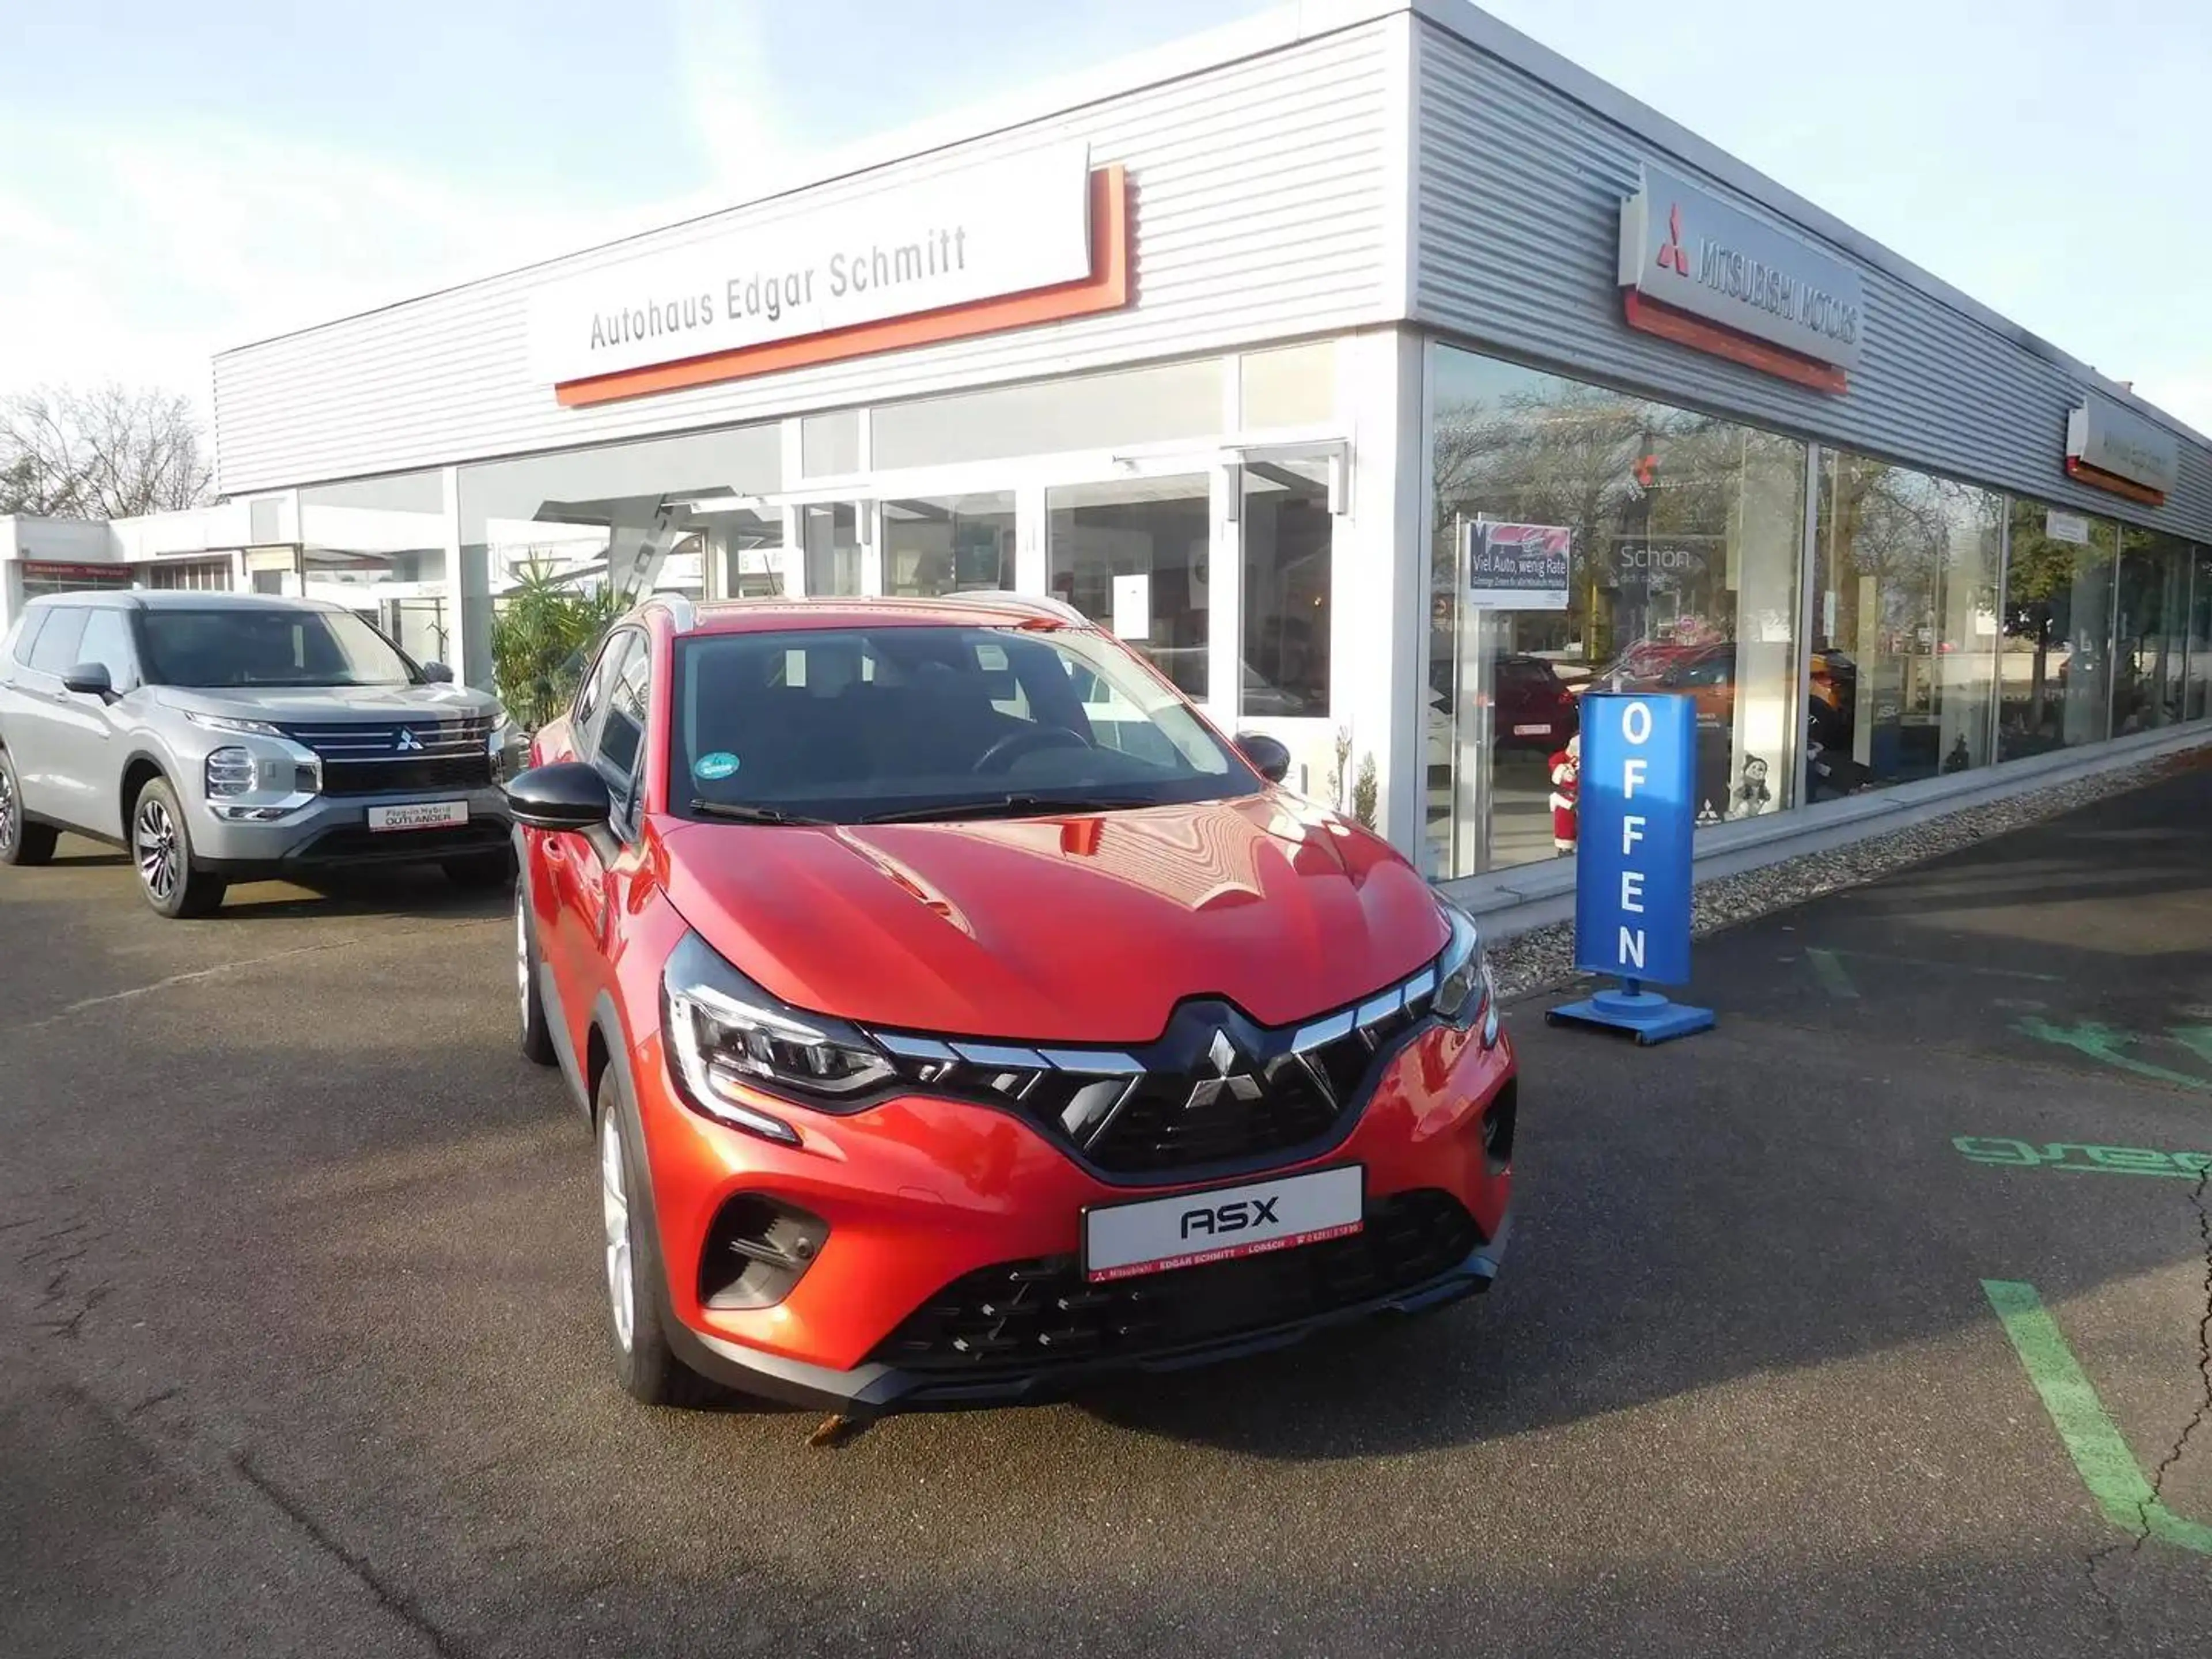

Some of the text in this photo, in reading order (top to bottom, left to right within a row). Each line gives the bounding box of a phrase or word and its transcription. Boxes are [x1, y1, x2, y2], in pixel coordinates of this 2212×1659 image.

[590, 225, 968, 350] Autohaus Edgar Schmitt
[1698, 236, 1858, 344] MITSUBISHI MOTORS
[1473, 553, 1566, 577] Viel Auto, wenig Rate
[1620, 545, 1690, 567] Schön
[385, 814, 451, 825] OUTLANDER
[1619, 701, 1652, 968] OFFEN
[1181, 1196, 1279, 1240] ASX
[1159, 1257, 1193, 1270] EDGAR
[1194, 1248, 1235, 1264] SCHMITT
